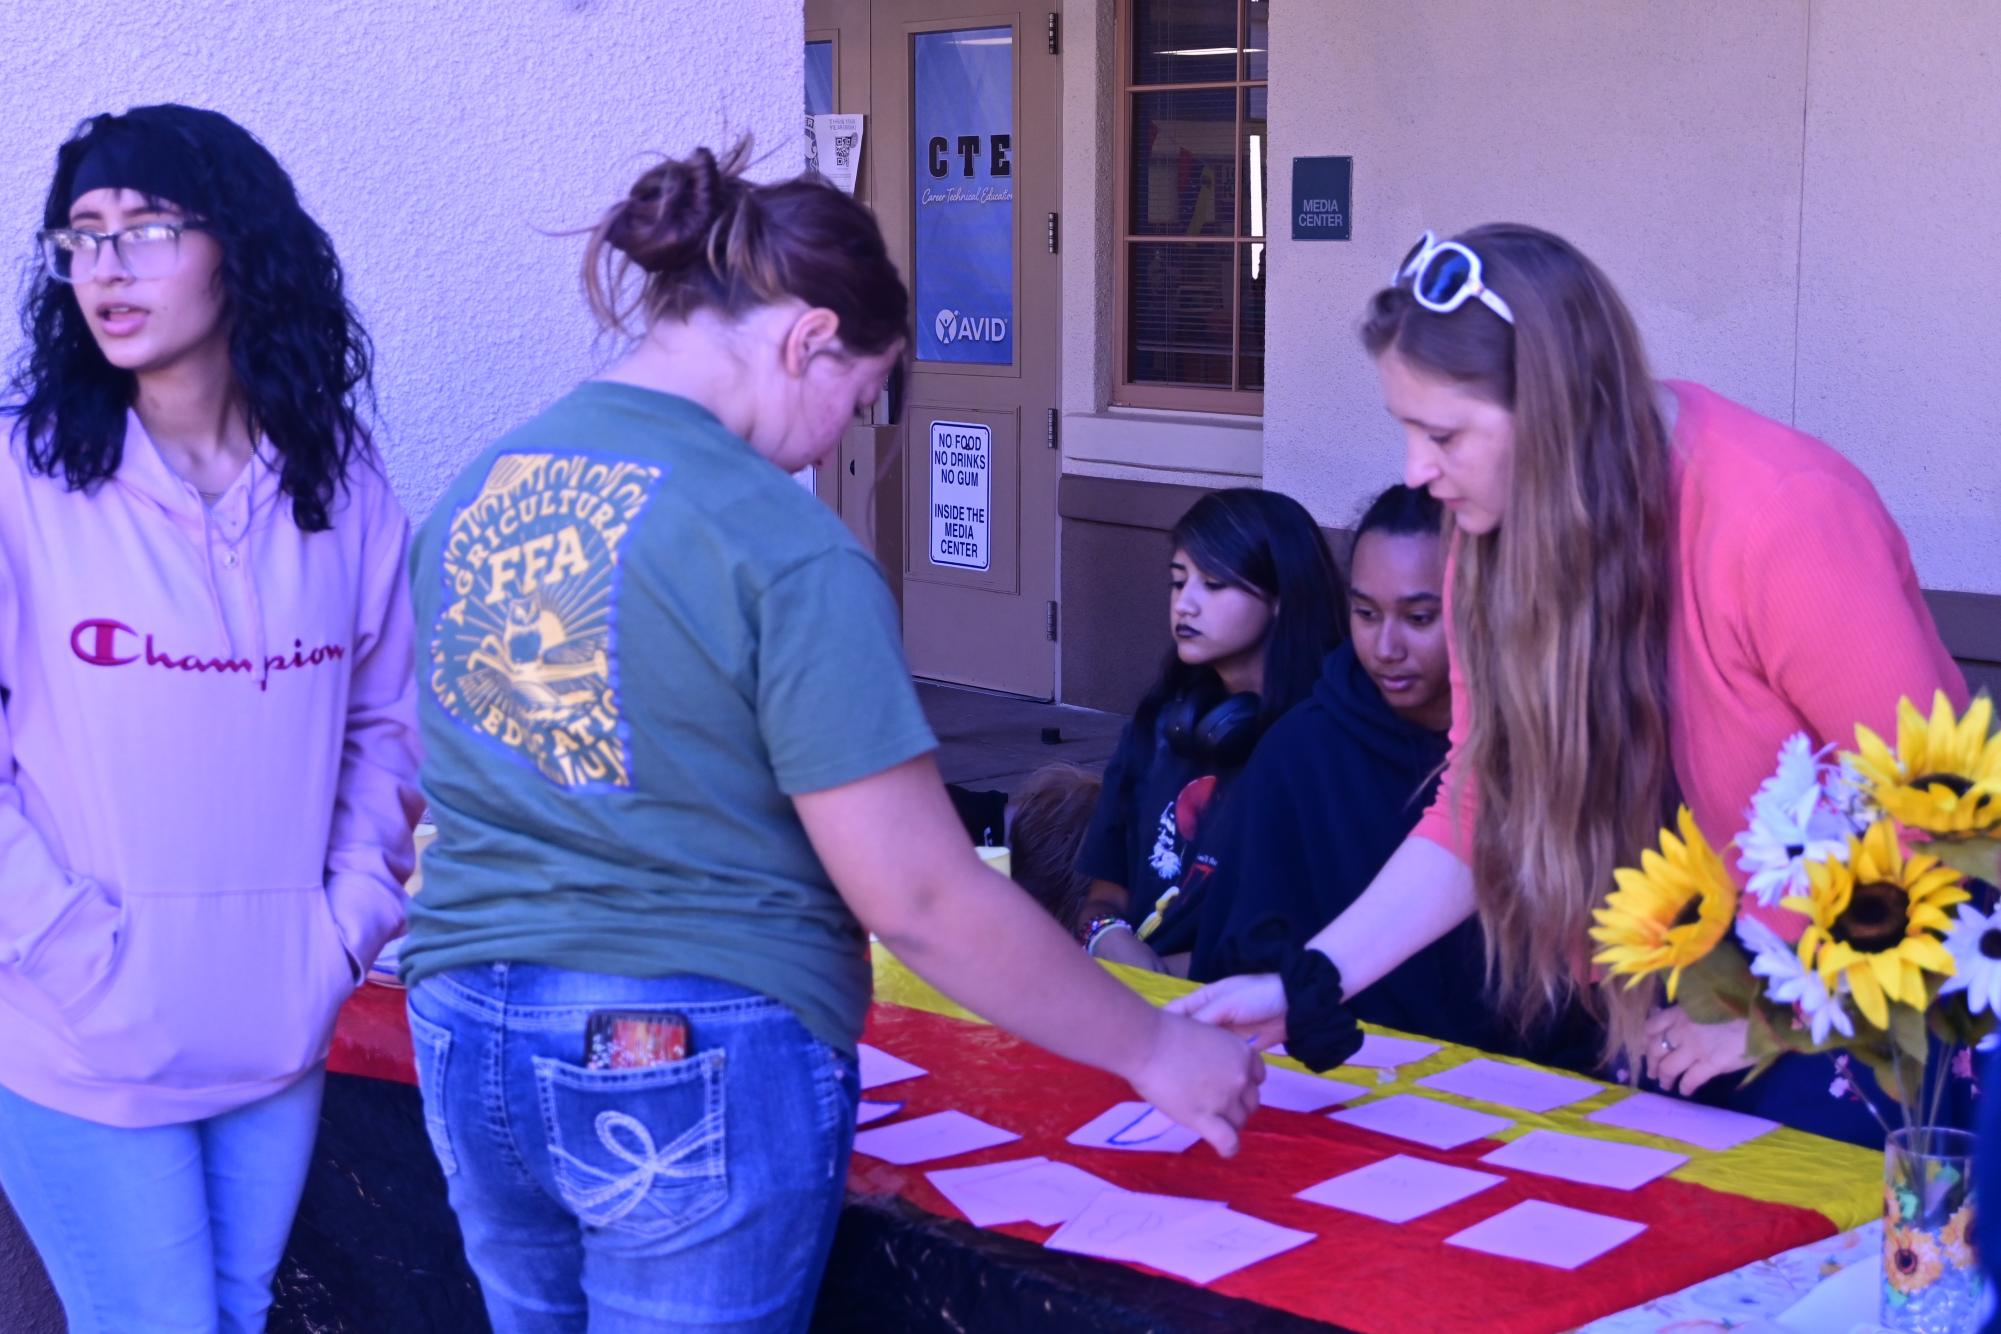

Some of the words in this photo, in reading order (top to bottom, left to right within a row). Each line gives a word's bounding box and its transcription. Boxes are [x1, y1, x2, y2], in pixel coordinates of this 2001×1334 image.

[928, 134, 1010, 178] CTE
[922, 188, 946, 205] Career
[946, 187, 981, 202] Technical
[1303, 199, 1339, 212] MEDIA
[1298, 213, 1343, 227] CENTER
[957, 316, 1007, 342] AVID
[939, 433, 952, 449] NO
[955, 435, 982, 451] FOOD
[934, 450, 948, 466] NO
[950, 452, 986, 470] DRINKS
[941, 468, 955, 484] NO
[957, 470, 979, 487] GUM
[934, 503, 965, 521] INSIDE
[966, 507, 985, 523] THE
[944, 522, 974, 540] MEDIA
[940, 539, 978, 558] CENTER
[484, 524, 591, 605] FFA
[70, 617, 345, 692] Champion
